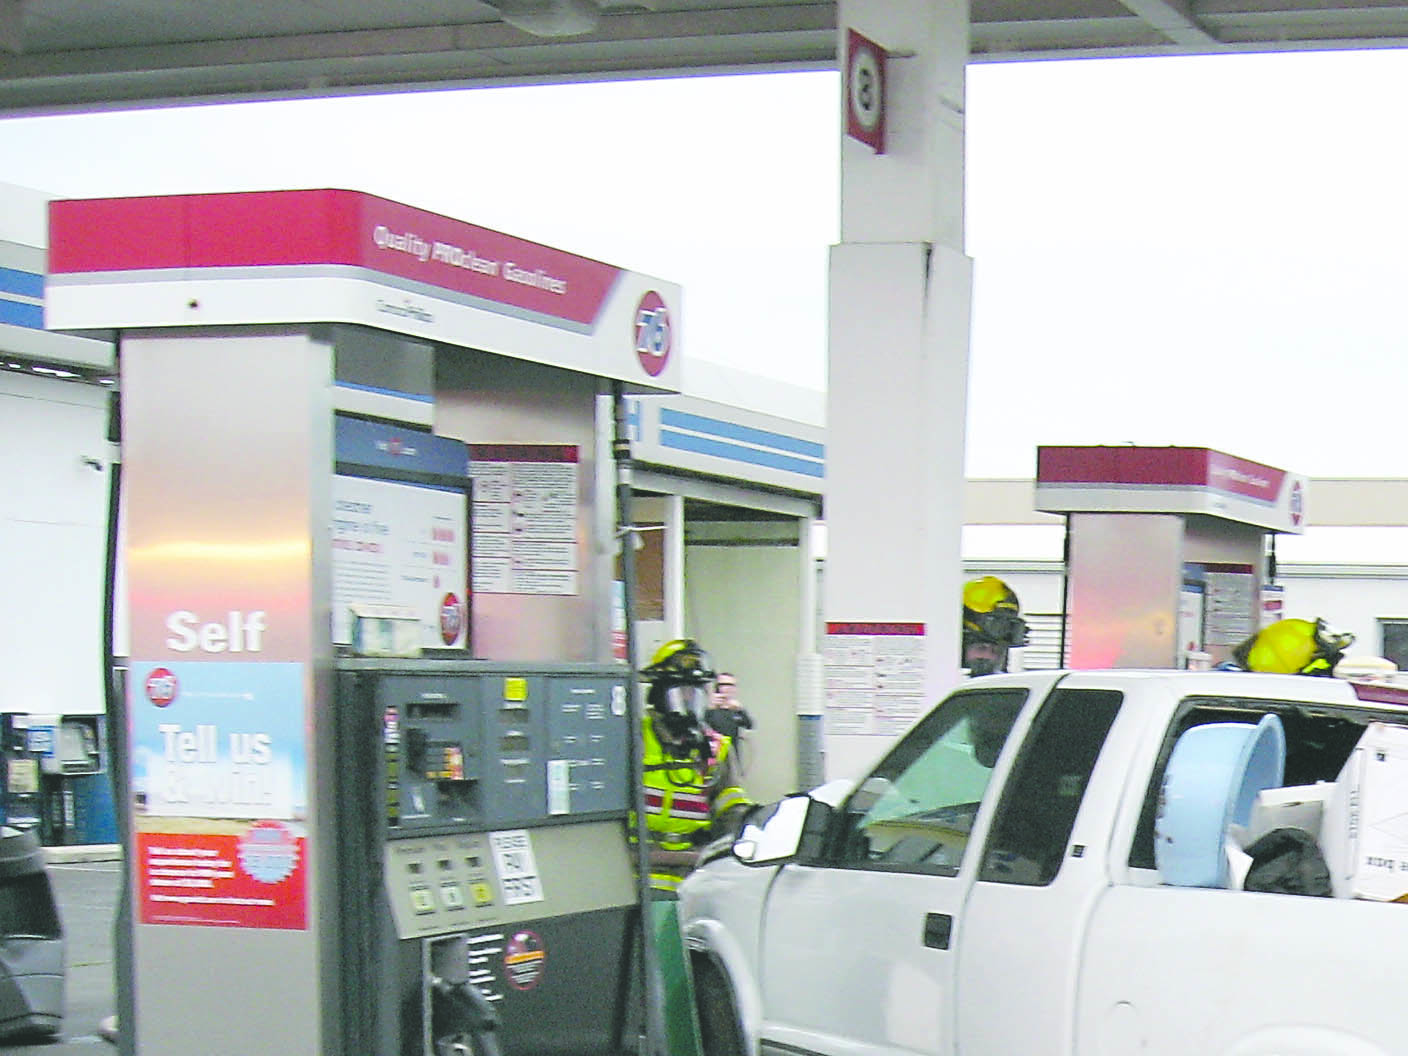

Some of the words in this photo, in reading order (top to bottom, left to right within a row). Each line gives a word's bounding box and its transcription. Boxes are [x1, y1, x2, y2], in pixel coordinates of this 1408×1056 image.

[373, 225, 431, 263] Quality
[503, 261, 569, 296] Gasolines
[636, 306, 668, 357] 76
[165, 610, 268, 653] Self
[157, 724, 218, 764] Tell
[228, 732, 273, 765] us
